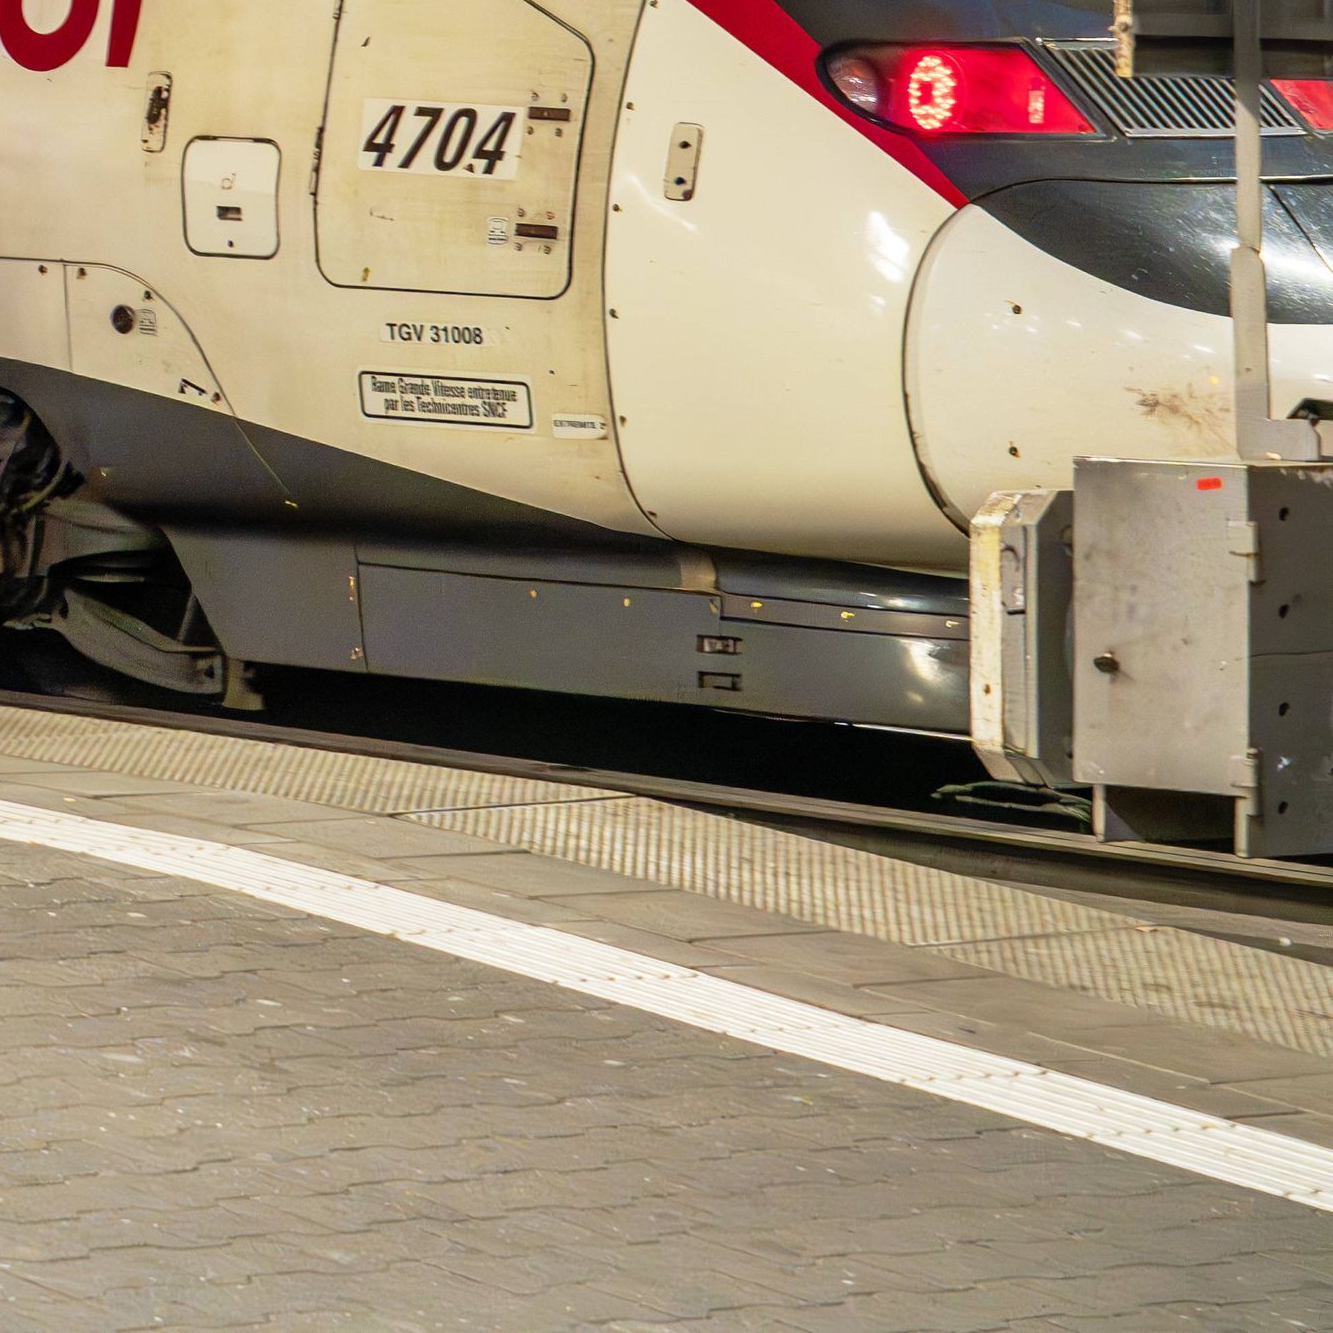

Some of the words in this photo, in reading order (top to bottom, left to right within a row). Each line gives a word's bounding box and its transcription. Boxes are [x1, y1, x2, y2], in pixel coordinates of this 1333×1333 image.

[362, 104, 518, 175] 4704
[386, 322, 424, 342] TGV
[429, 325, 484, 345] 31008
[371, 375, 397, 395] Rame
[397, 377, 431, 396] Grande
[432, 379, 466, 399] Vitesse
[467, 383, 518, 403] entretenue
[383, 397, 399, 414] par
[400, 395, 415, 412] les
[416, 395, 481, 417] Technicentres
[482, 400, 509, 419] SNCF
